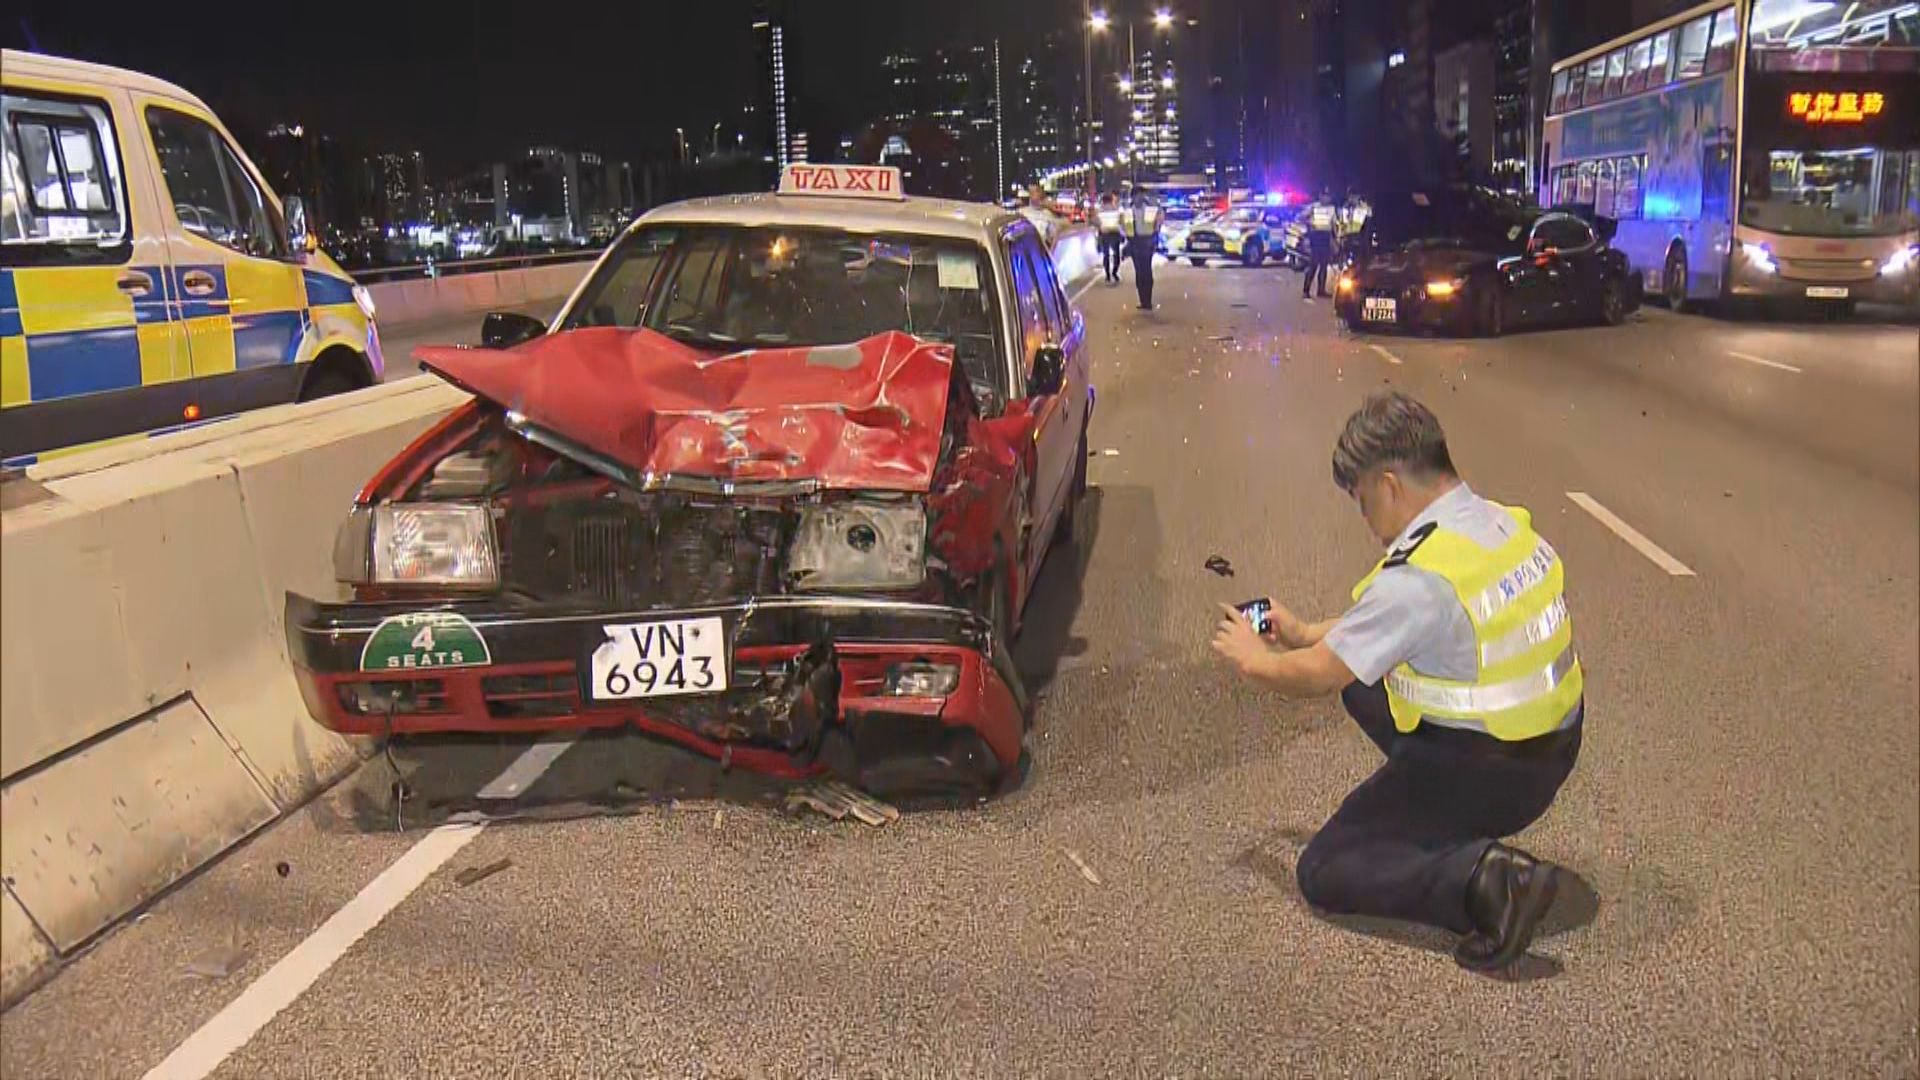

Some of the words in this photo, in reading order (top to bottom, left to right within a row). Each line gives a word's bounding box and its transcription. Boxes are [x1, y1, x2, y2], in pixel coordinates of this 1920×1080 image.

[790, 166, 891, 191] TAXI
[411, 625, 435, 651] 4
[631, 624, 684, 659] VN
[387, 650, 463, 668] SEATS
[605, 656, 714, 695] 6943
